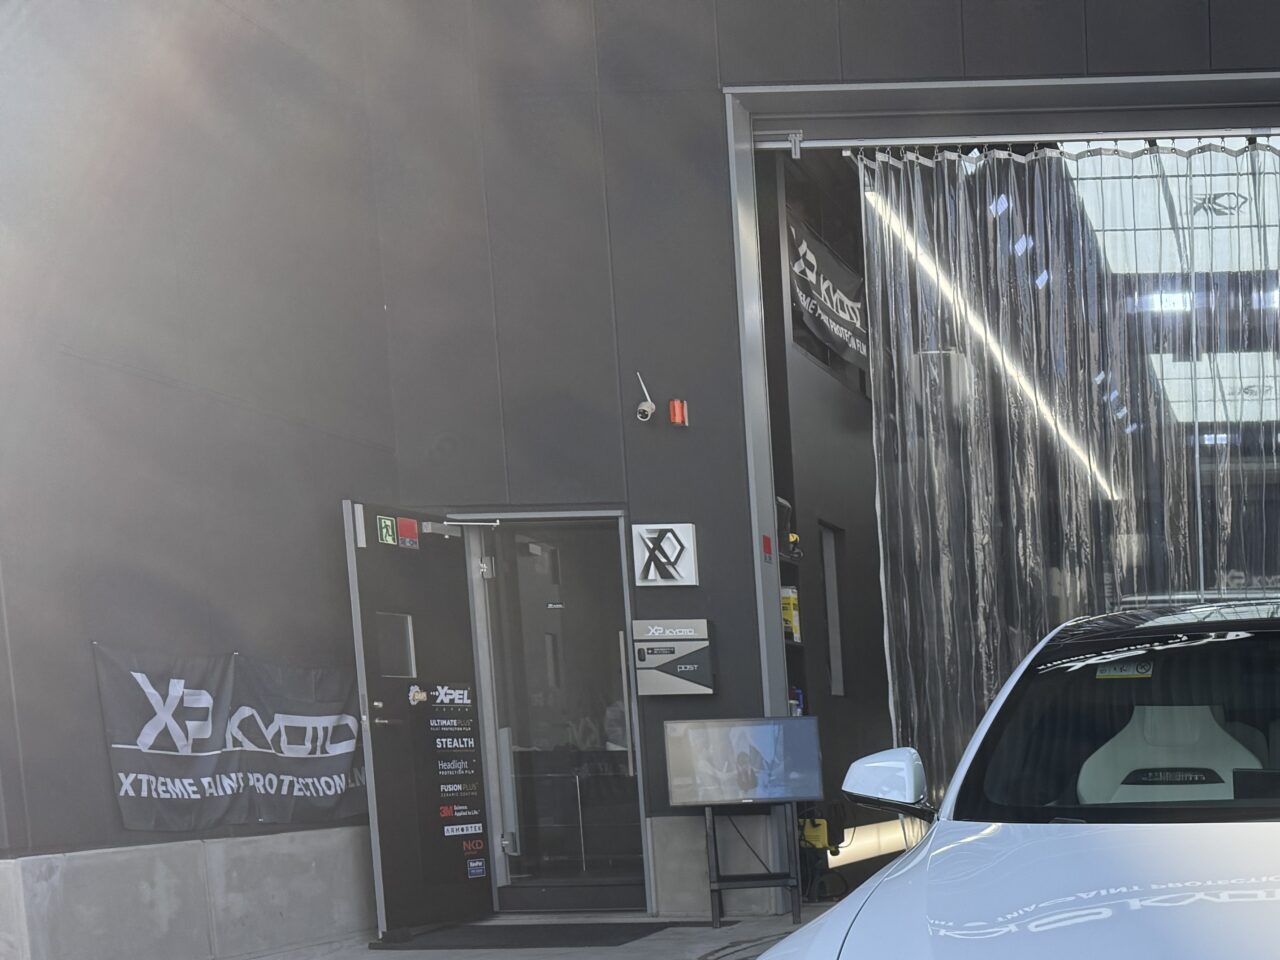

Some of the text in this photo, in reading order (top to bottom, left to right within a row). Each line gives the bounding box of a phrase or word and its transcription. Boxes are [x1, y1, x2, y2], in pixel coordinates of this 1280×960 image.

[648, 626, 695, 636] XP KYOTO
[435, 685, 471, 704] XPEL
[130, 671, 359, 757] XP KYOTO
[436, 738, 475, 749] STEALTH
[438, 760, 468, 771] Headlight
[118, 772, 201, 799] XTREME
